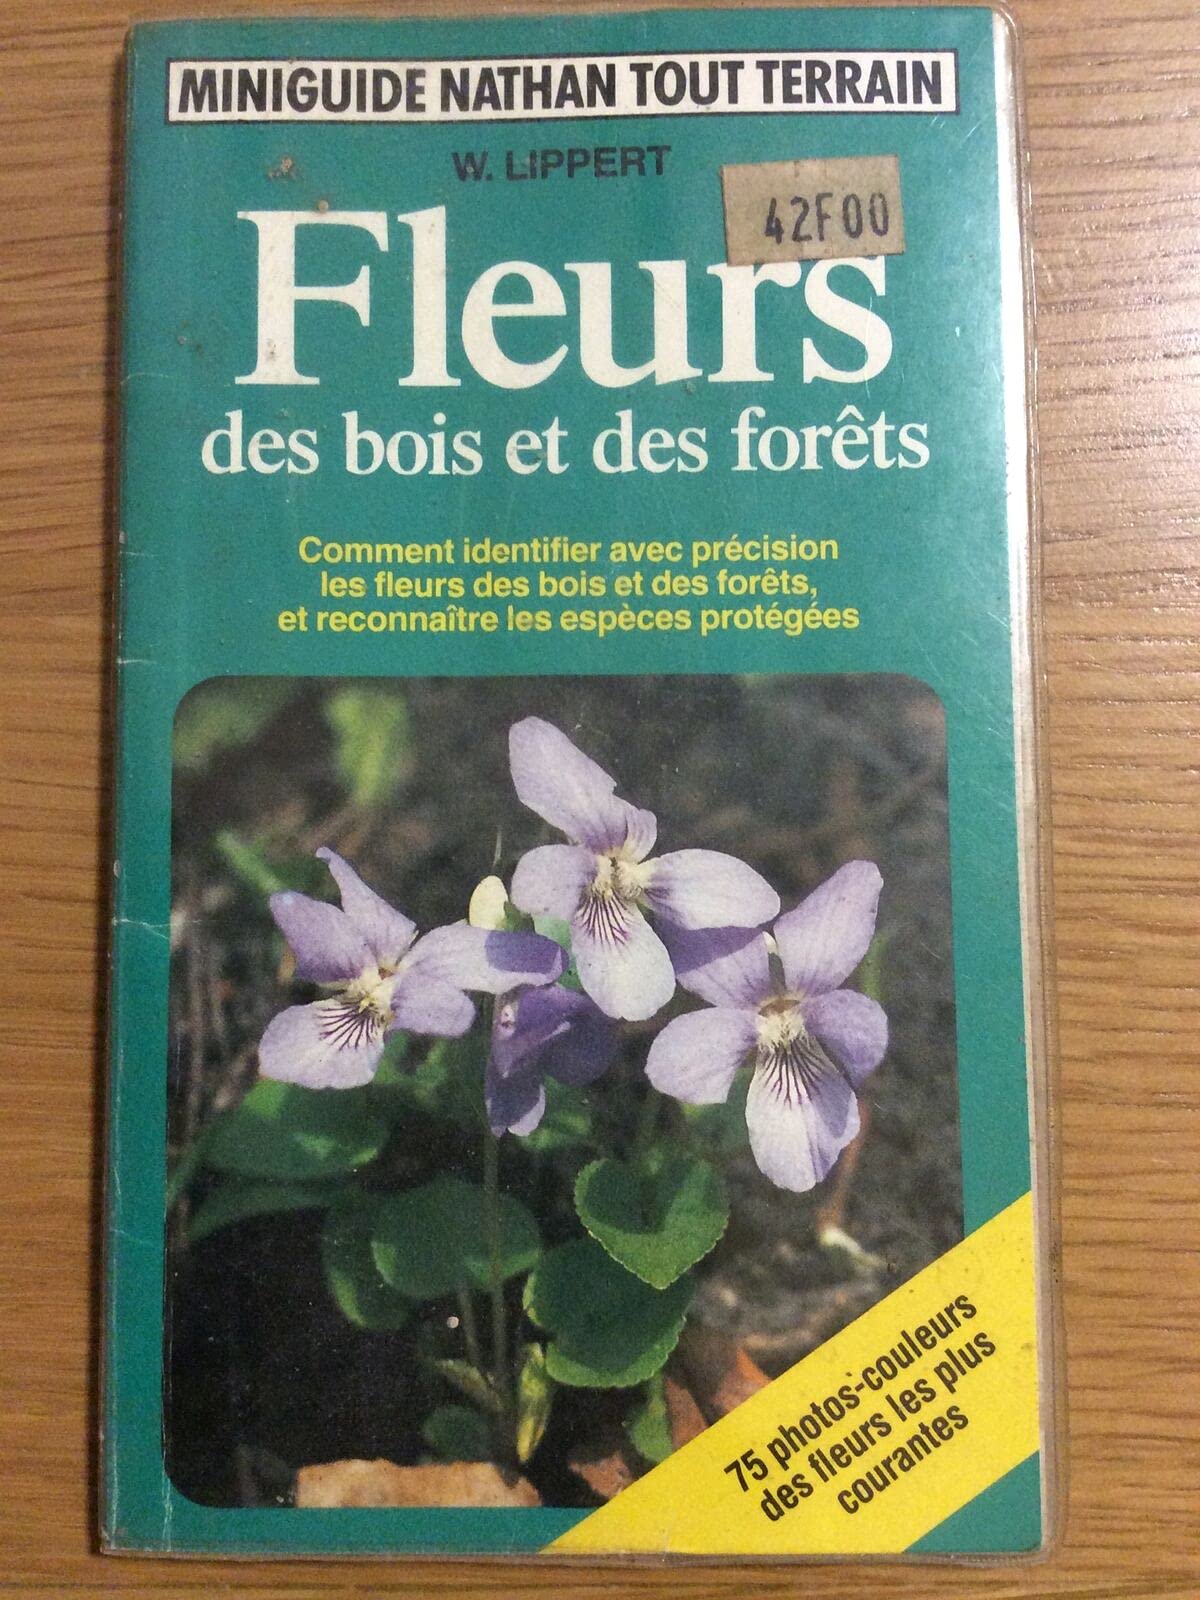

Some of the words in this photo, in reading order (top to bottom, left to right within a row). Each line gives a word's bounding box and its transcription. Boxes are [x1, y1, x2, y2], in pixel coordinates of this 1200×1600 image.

[178, 66, 426, 113] MINIGUIDE
[441, 64, 616, 112] NATHAN
[629, 61, 745, 107] TOUT
[757, 58, 943, 104] TERRAIN
[452, 151, 493, 182] W.
[505, 145, 672, 181] LIPPERT
[764, 191, 890, 245] 42F00
[234, 204, 895, 389] Fleurs
[201, 408, 319, 476] des
[344, 411, 483, 476] bois
[505, 416, 570, 475] et
[591, 409, 707, 474] des
[730, 405, 930, 473] forêts
[298, 535, 454, 565] Comment
[463, 536, 602, 563] identifier
[609, 540, 683, 563] avec
[691, 534, 839, 568] précision
[320, 570, 366, 598] les
[374, 569, 465, 598] fleurs
[474, 569, 530, 598] des
[538, 569, 606, 598] bois
[615, 571, 643, 597] et
[651, 568, 708, 597] des
[715, 567, 819, 602] forêts,
[277, 607, 309, 632] et
[316, 602, 499, 633] reconnaître
[507, 604, 552, 632] les
[560, 602, 692, 638] espèces
[700, 600, 860, 637] protégées
[723, 1449, 769, 1492] 75
[766, 1294, 977, 1471] photos-couleurs
[760, 1472, 814, 1522] des
[807, 1412, 892, 1483] fleurs
[885, 1378, 937, 1422] les
[933, 1331, 996, 1394] plus
[837, 1405, 969, 1514] courantes
